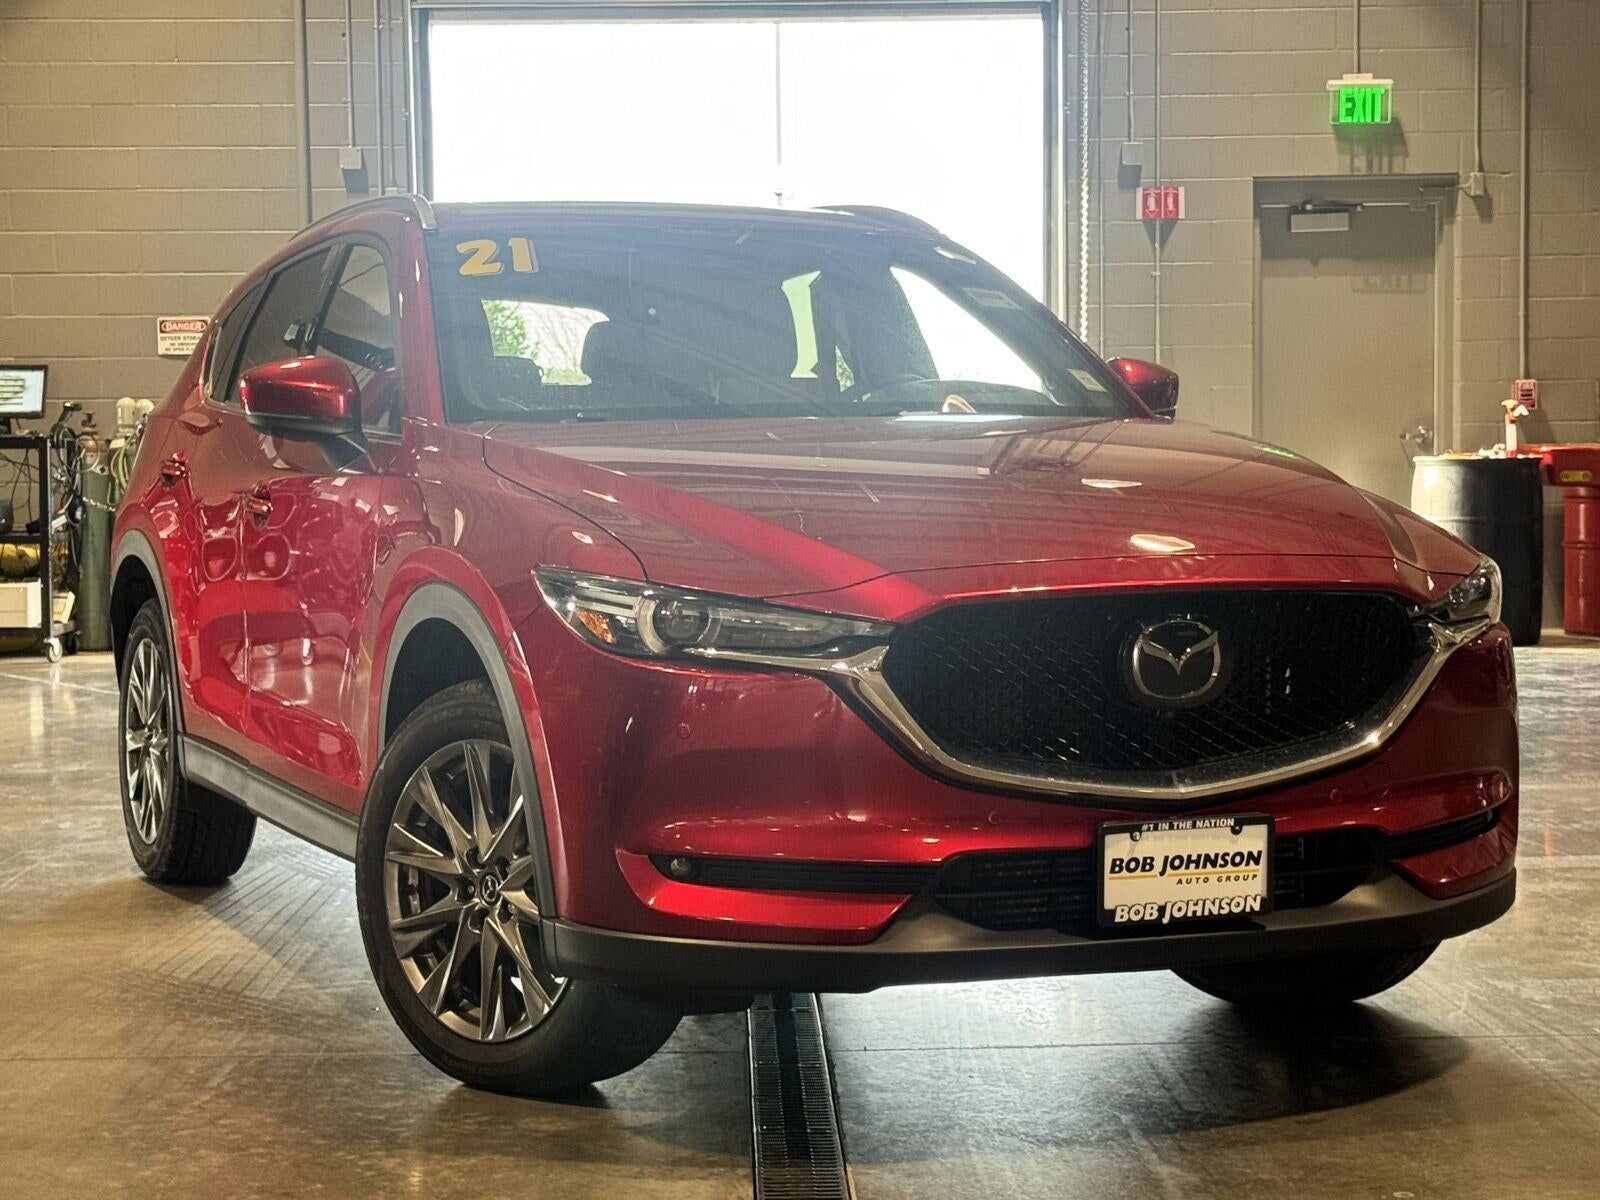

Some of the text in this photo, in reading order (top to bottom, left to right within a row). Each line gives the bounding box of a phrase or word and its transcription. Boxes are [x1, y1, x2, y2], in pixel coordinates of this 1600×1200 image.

[1339, 87, 1385, 122] EXIT
[456, 237, 539, 277] 21
[166, 321, 202, 331] DANGER
[1158, 822, 1169, 831] IN
[1173, 820, 1192, 830] THE
[1196, 818, 1235, 828] NATION
[1109, 850, 1263, 876] BOB JOHNSON
[1176, 873, 1258, 885] AUTO GROUP
[1114, 896, 1261, 924] BOB JOHNSON
